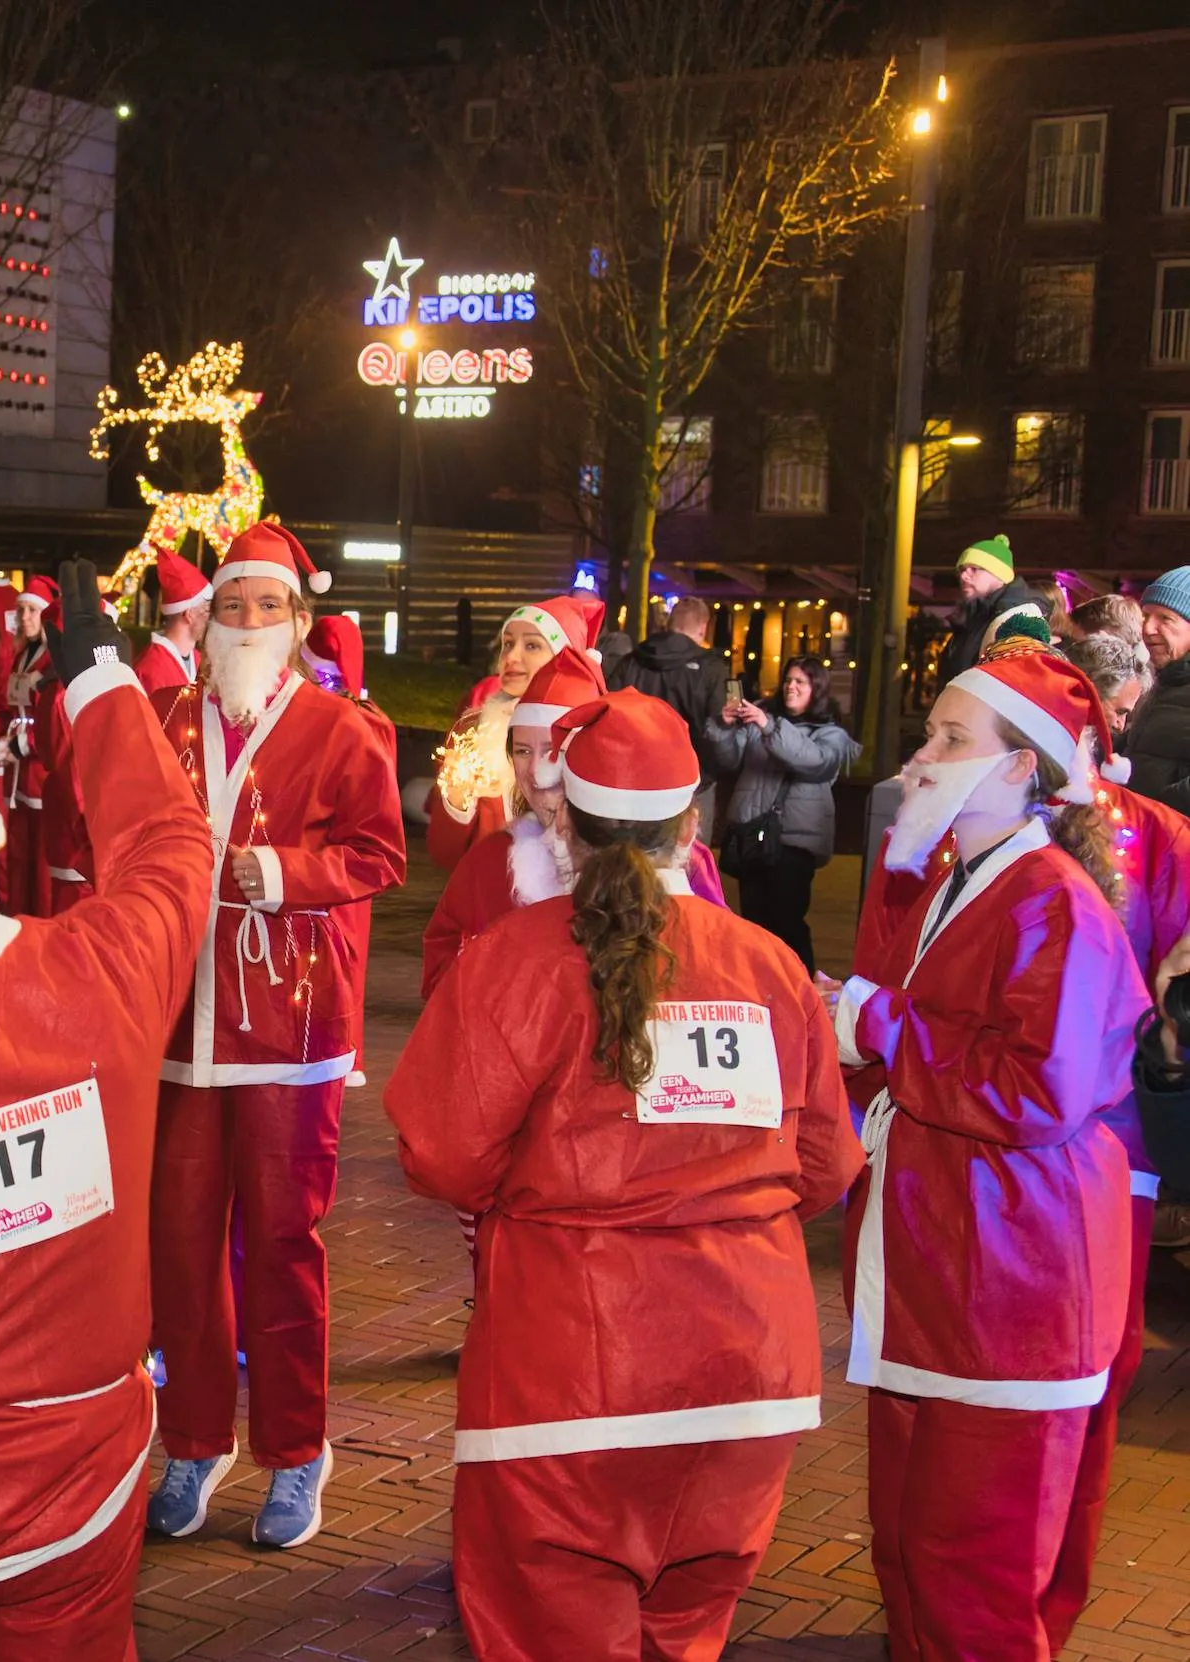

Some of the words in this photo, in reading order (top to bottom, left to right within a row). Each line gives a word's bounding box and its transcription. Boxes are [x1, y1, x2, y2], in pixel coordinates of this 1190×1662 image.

[358, 341, 534, 386] Queens
[646, 1004, 688, 1022] ANTA
[692, 1004, 744, 1023] EVENING
[748, 1006, 765, 1025] RUN
[687, 1026, 740, 1070] 13
[660, 1076, 684, 1088] EEN
[53, 1088, 83, 1115] RUN
[651, 1090, 731, 1107] EENZAAMHEID
